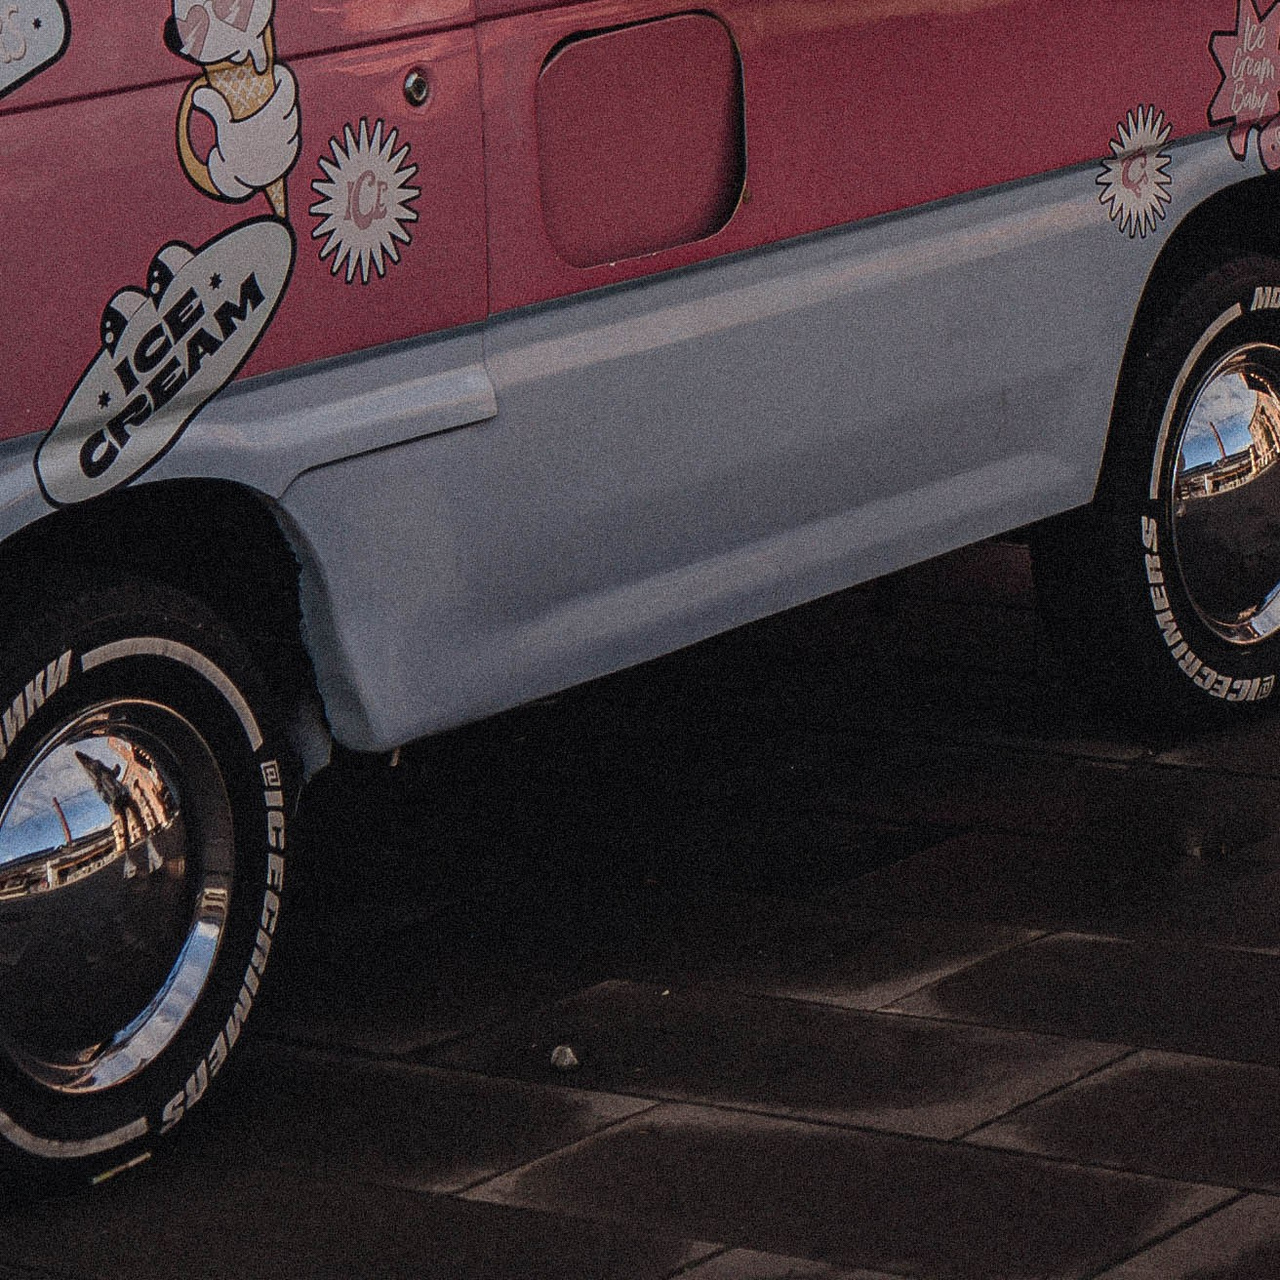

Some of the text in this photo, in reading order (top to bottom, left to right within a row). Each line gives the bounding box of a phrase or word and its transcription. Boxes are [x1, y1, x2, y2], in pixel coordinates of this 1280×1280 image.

[343, 169, 389, 230] ICE
[79, 272, 266, 479] CREAM
[115, 287, 206, 397] ICE
